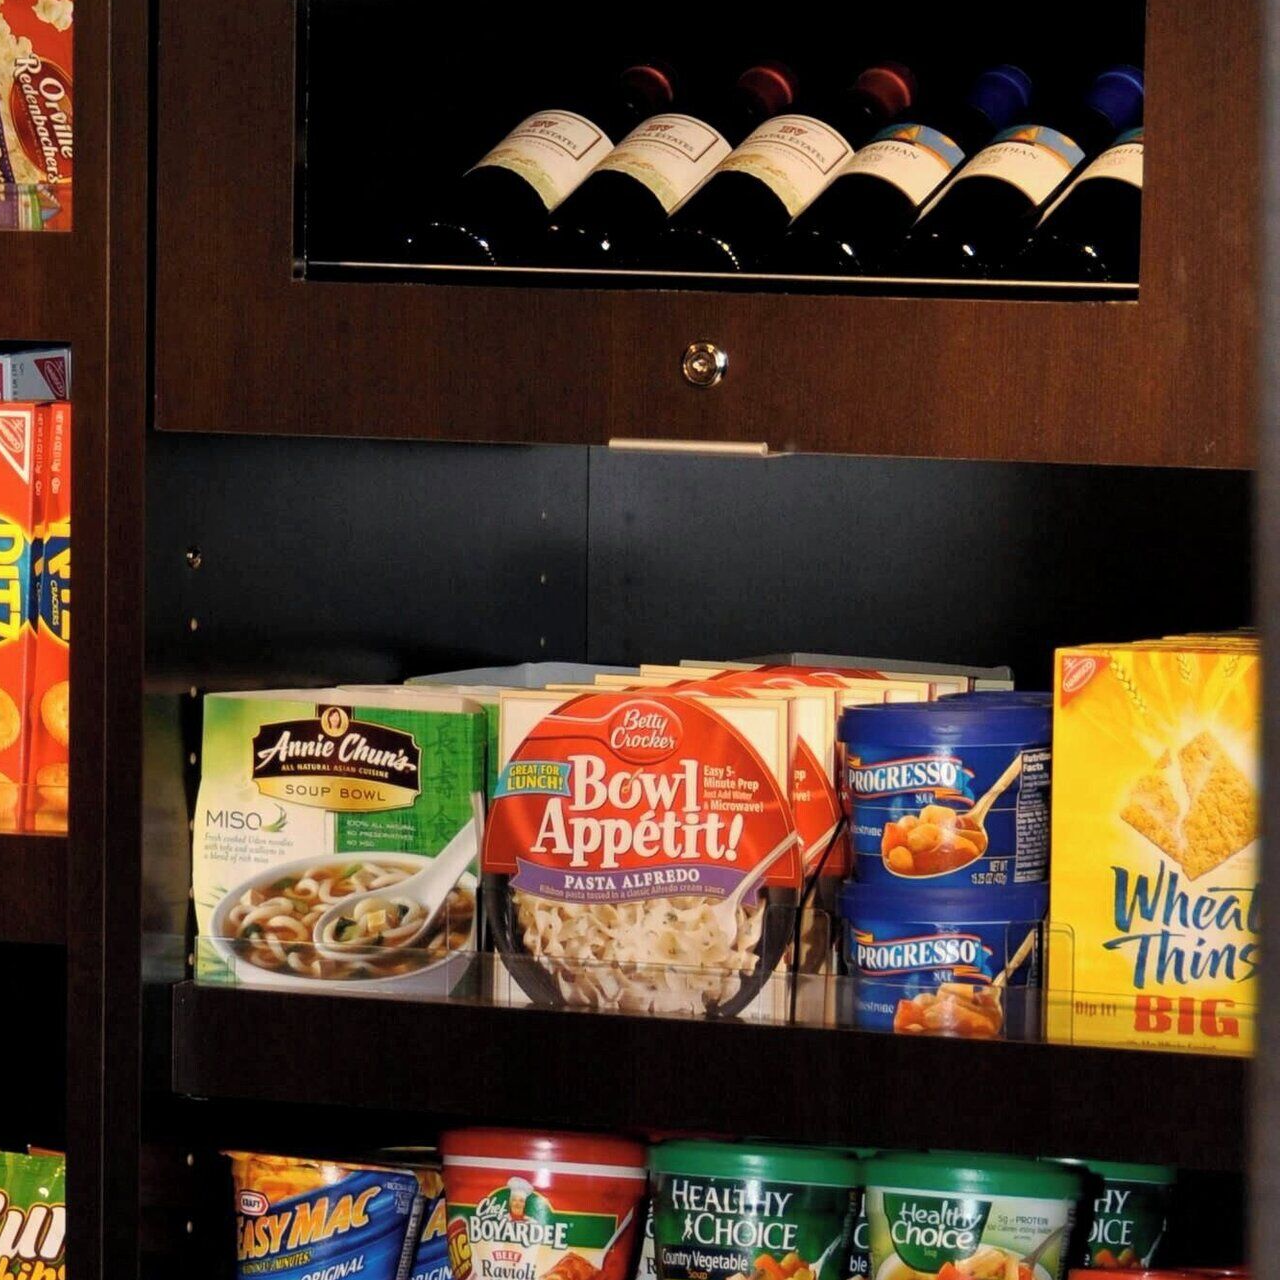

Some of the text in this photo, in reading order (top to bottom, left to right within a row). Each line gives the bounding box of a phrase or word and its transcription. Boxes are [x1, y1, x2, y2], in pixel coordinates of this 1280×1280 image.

[14, 51, 63, 186] Redenbacher's
[38, 76, 73, 160] Orville
[623, 708, 668, 732] Betty
[255, 730, 416, 771] Annie Chun's
[610, 725, 675, 750] Crocker
[297, 763, 331, 771] NATURAL
[333, 764, 356, 773] ASIAN
[358, 767, 389, 779] CUISINE
[506, 775, 564, 791] LUNCH!
[509, 764, 560, 777] GREAT FOR
[568, 754, 701, 812] Bowl
[703, 765, 724, 779] Easy
[848, 761, 957, 792] PROGRESSO
[285, 784, 386, 802] SOUP BOWL
[703, 777, 759, 794] Minute Prep
[710, 799, 764, 813] Microwave!
[206, 809, 262, 830] MISO
[530, 797, 744, 868] Appétit!
[564, 869, 700, 891] PASTA ALFREDO
[1110, 859, 1261, 935] Wheat
[857, 939, 976, 970] PROGRESSO
[1102, 929, 1260, 989] Thins
[1134, 994, 1239, 1038] BIG
[242, 1198, 261, 1209] KRAFT
[476, 1196, 508, 1221] Chef
[672, 1178, 793, 1218] HEALTHY
[236, 1185, 382, 1261] EASY MAC
[898, 1200, 983, 1232] Healthy
[1016, 1216, 1049, 1226] PROTEIN
[469, 1215, 569, 1250] BOYARDEE
[693, 1213, 798, 1250] CHOICE
[891, 1221, 970, 1249] Choice
[494, 1251, 521, 1262] BEEF
[662, 1248, 748, 1272] Country Vegetable
